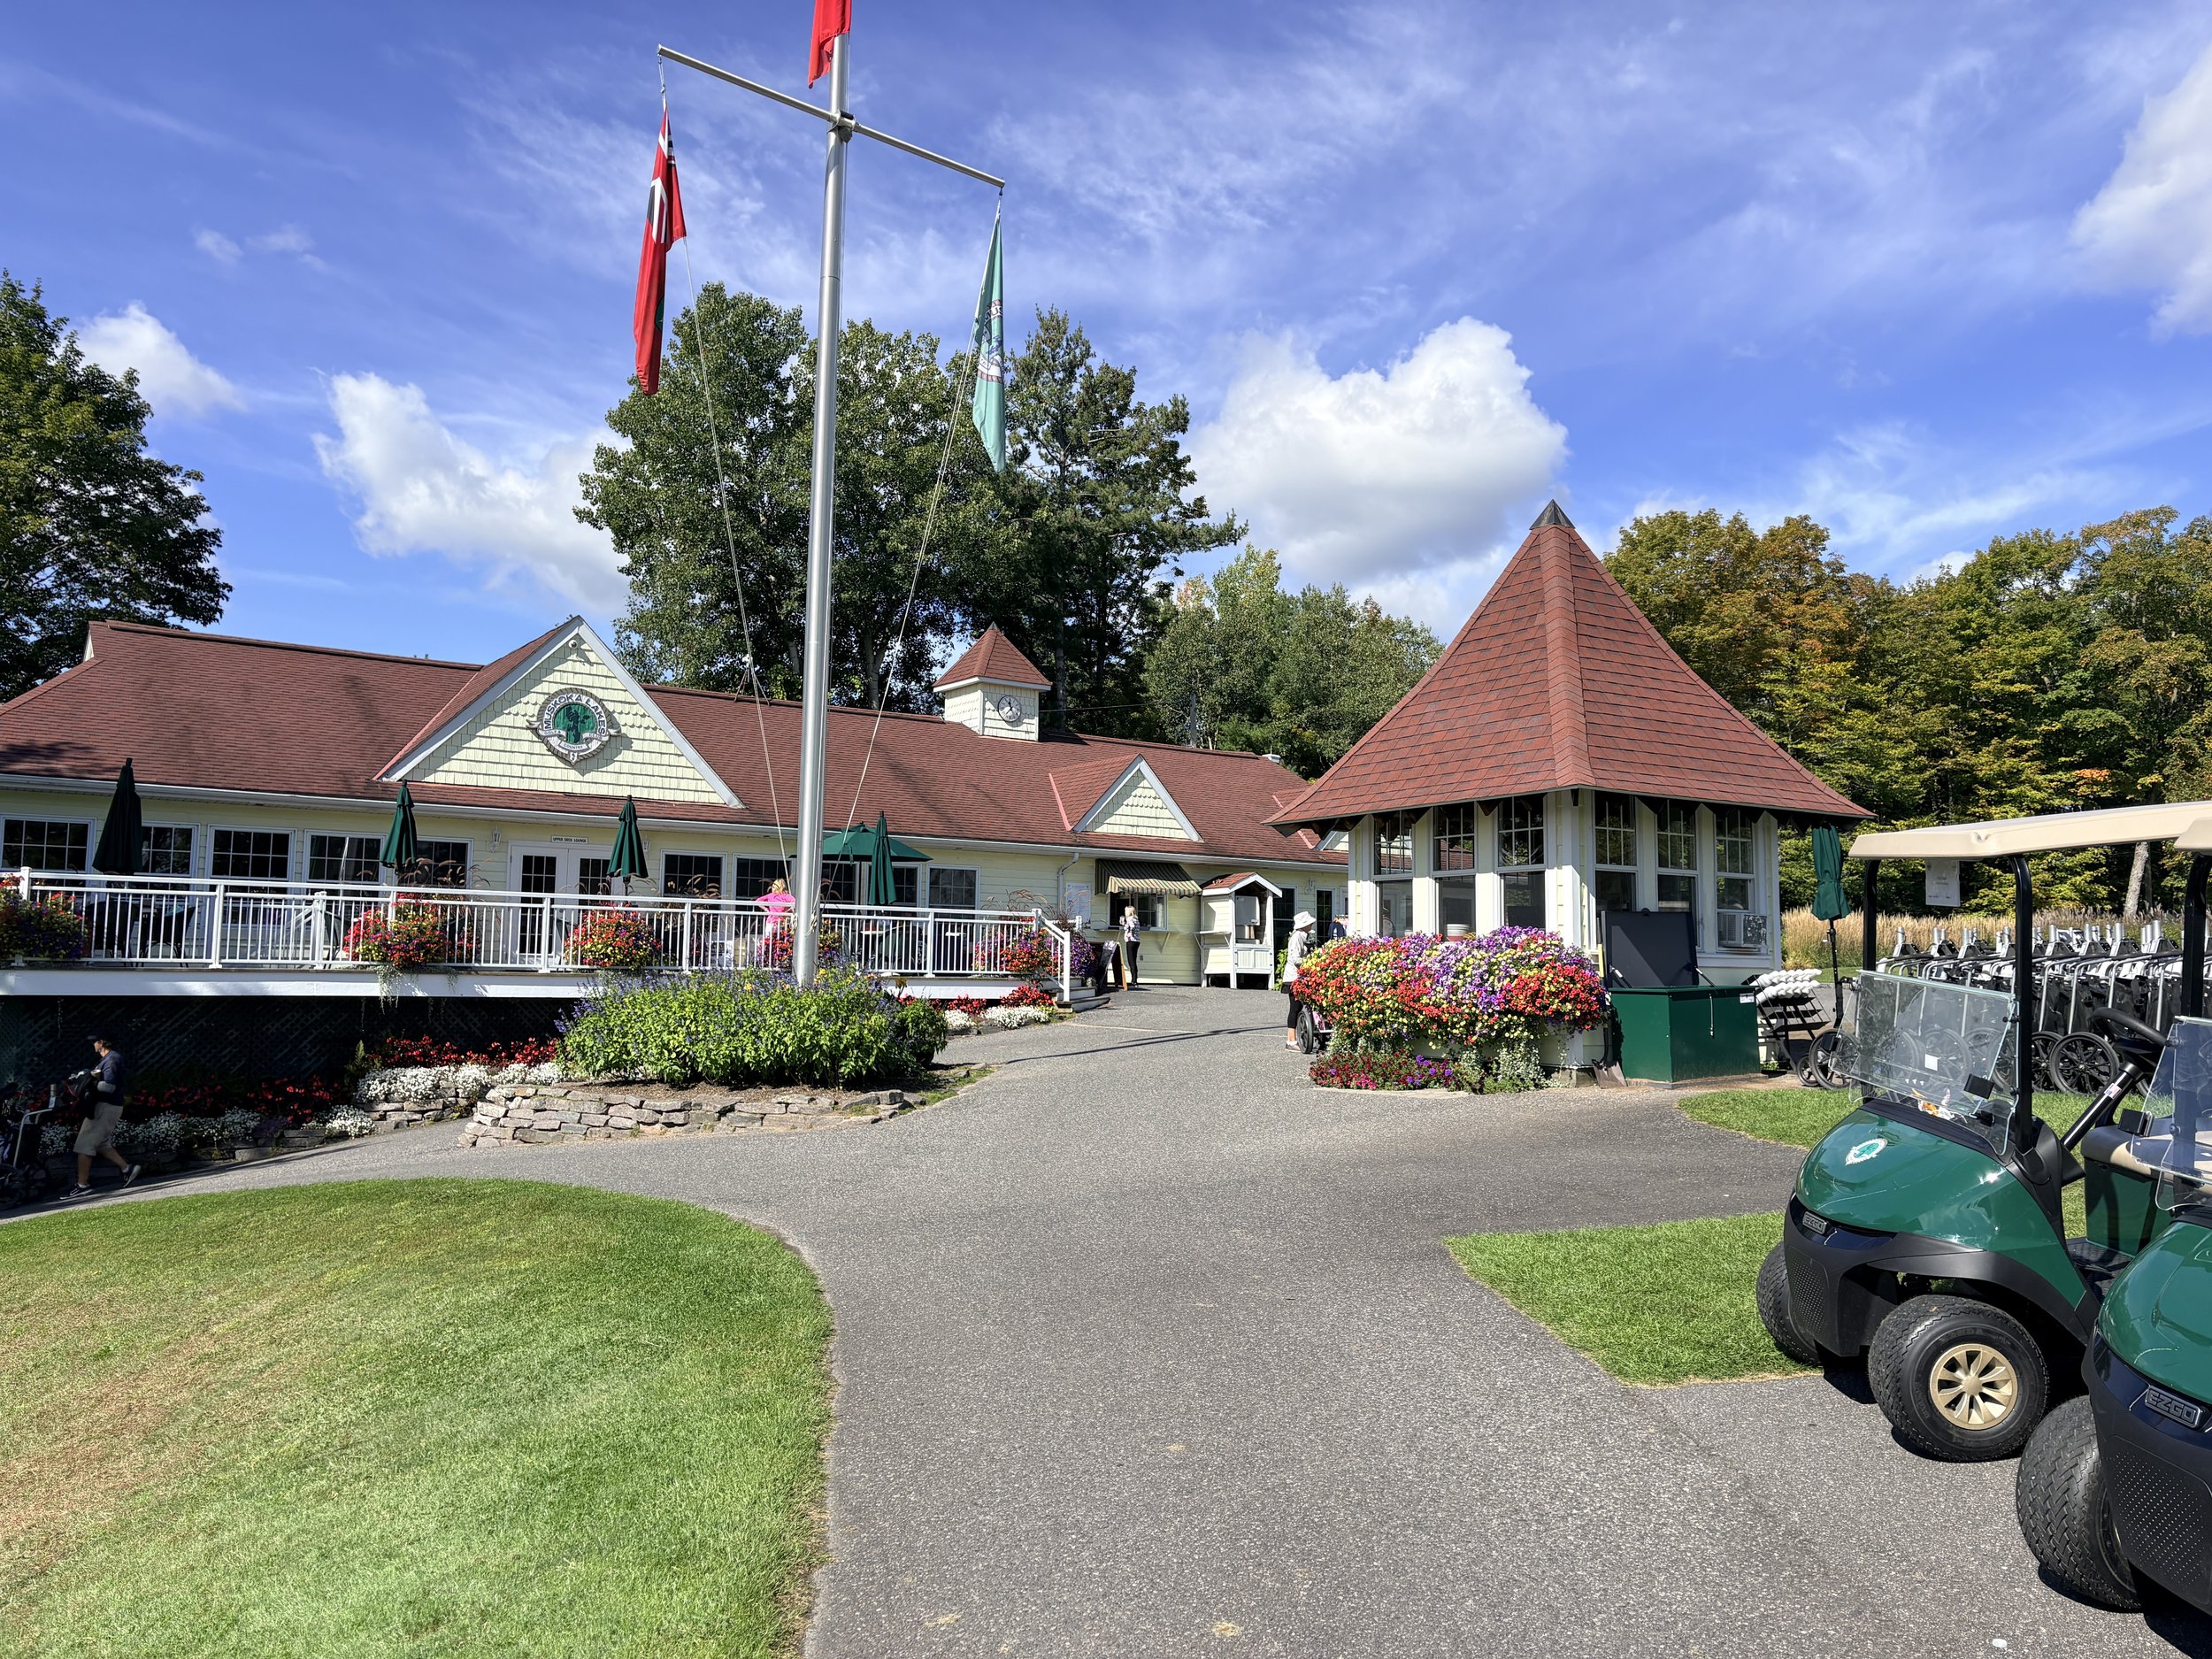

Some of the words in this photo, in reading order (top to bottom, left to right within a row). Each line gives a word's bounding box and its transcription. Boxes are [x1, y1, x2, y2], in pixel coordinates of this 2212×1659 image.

[543, 694, 583, 730] MUSKOKA
[585, 697, 606, 735] LAKES
[2147, 1389, 2197, 1423] EZGO
